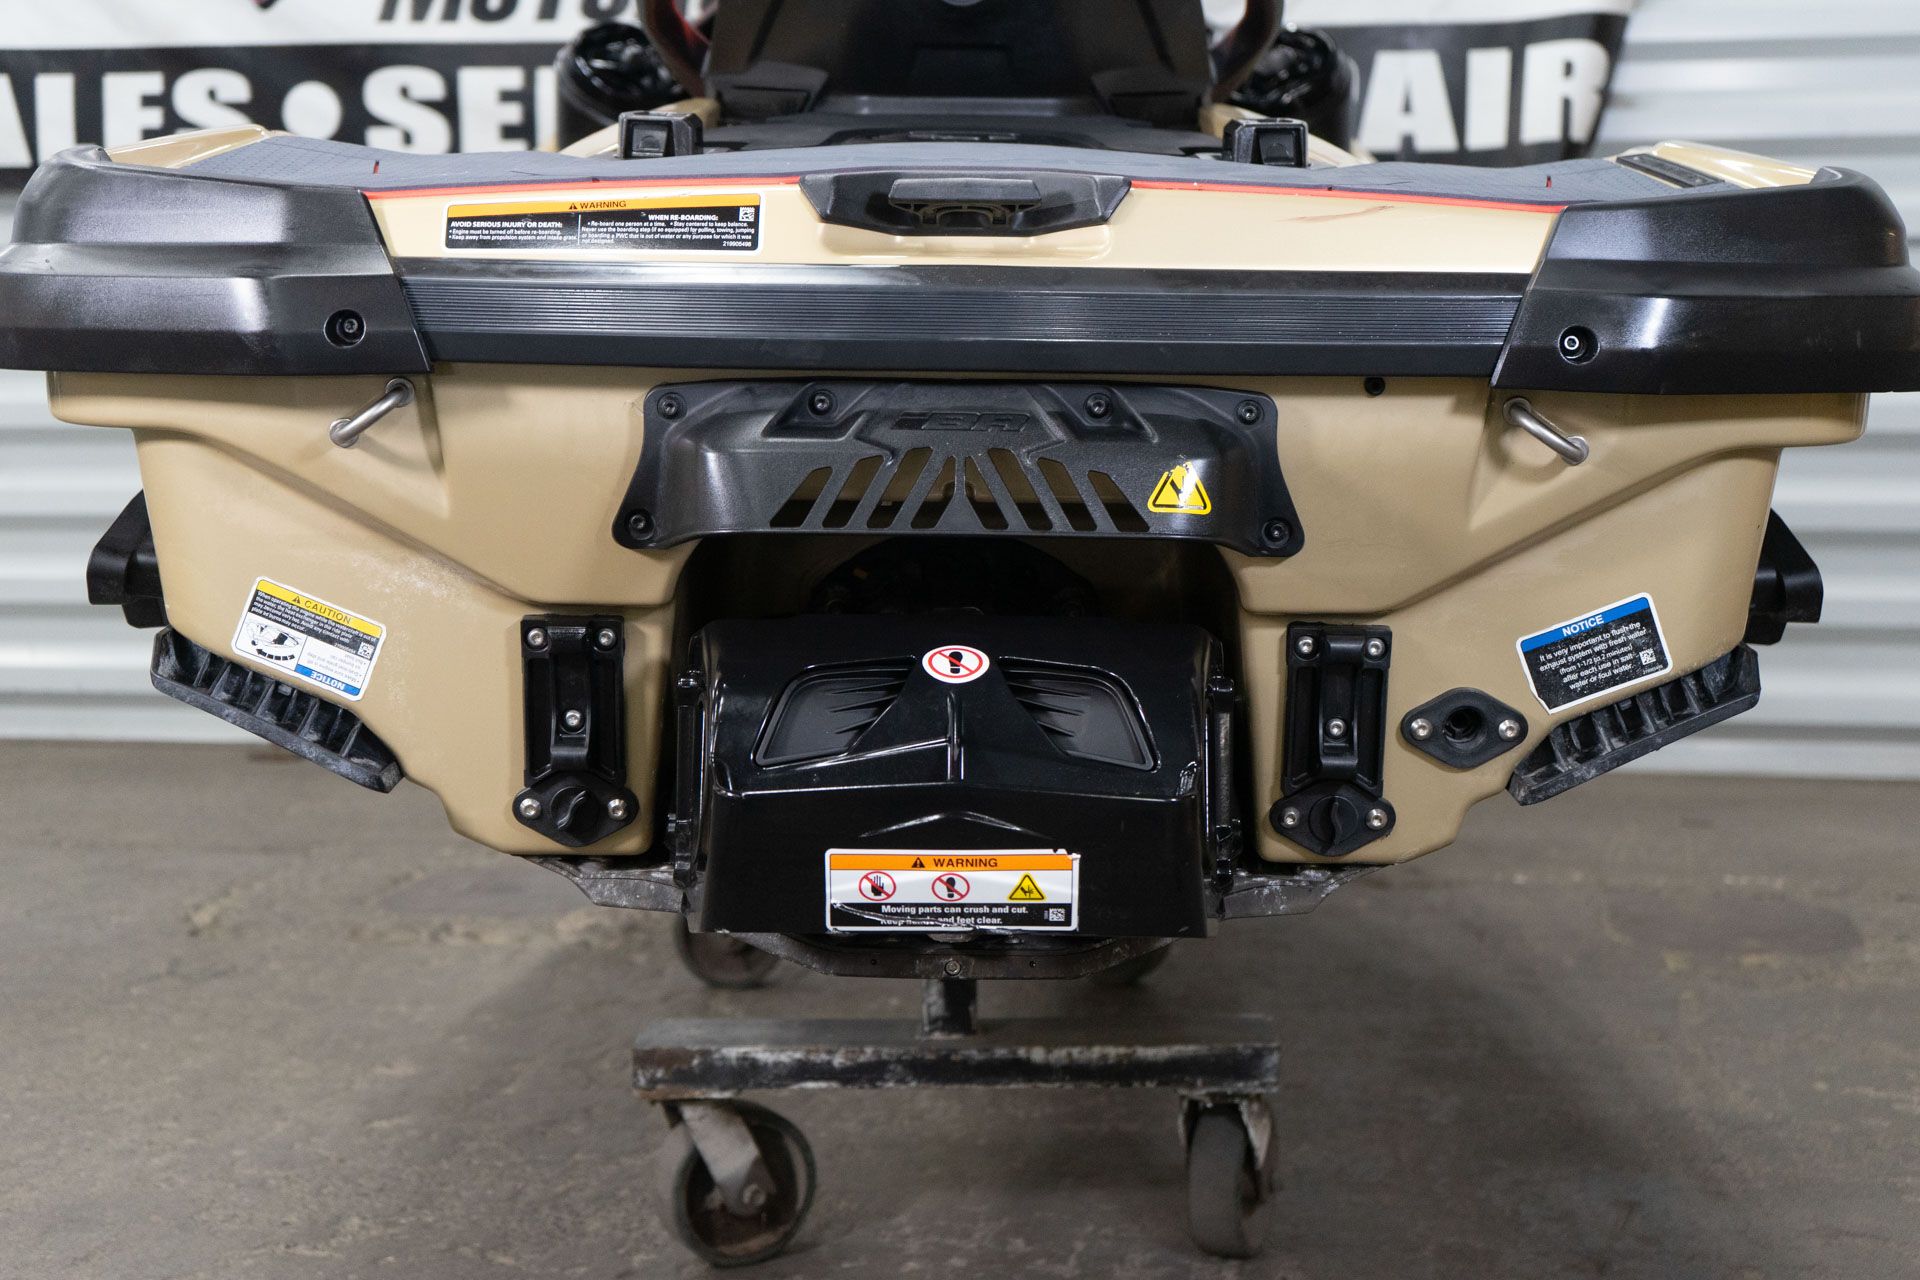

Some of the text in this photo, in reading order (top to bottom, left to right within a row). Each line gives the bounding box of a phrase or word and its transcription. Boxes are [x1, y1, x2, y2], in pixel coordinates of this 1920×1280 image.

[580, 200, 627, 209] WARNING
[304, 600, 351, 624] CAUTION
[1561, 614, 1604, 636] NOTICE
[1553, 647, 1569, 659] very
[1569, 635, 1602, 652] important
[1602, 631, 1610, 639] to
[1610, 625, 1627, 636] flush
[1629, 620, 1641, 630] the
[1538, 657, 1567, 672] exhaust
[1567, 648, 1592, 662] system
[1593, 641, 1608, 652] with
[1607, 634, 1626, 646] fresh
[1559, 663, 1576, 675] (from
[1576, 658, 1593, 668] 1-1/2
[1605, 642, 1633, 658] minutes)
[309, 670, 345, 689] NOTICE
[1562, 672, 1579, 683] after
[1579, 665, 1597, 677] each
[1597, 661, 1611, 670] use
[1611, 657, 1619, 665] in
[1569, 678, 1588, 690] water
[1597, 668, 1612, 680] foul
[1612, 661, 1634, 674] water.
[933, 858, 998, 868] WARNING
[881, 905, 916, 914] Moving
[918, 905, 942, 914] parts
[964, 905, 989, 914] crush
[992, 905, 1010, 914] and
[1011, 905, 1028, 914] cut.
[977, 916, 1003, 924] clear.
